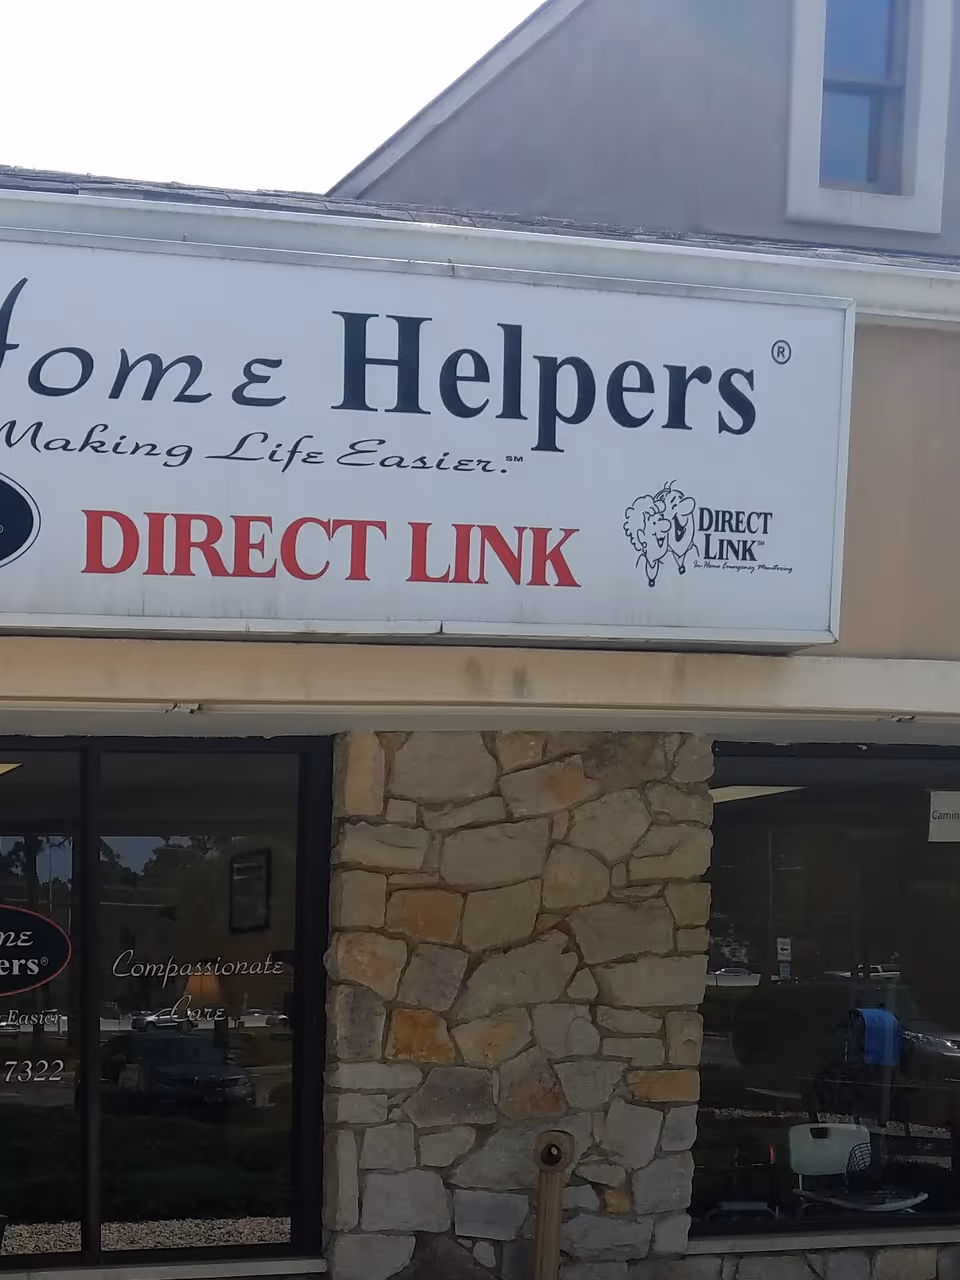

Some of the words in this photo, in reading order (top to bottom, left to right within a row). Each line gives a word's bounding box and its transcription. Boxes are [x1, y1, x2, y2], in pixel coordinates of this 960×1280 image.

[205, 431, 325, 473] Life
[697, 507, 773, 534] DIRECT
[81, 509, 387, 582] DIRECT
[406, 521, 582, 588] LINK
[703, 533, 757, 561] LINK
[112, 949, 284, 988] Compassionate
[171, 994, 226, 1021] Care
